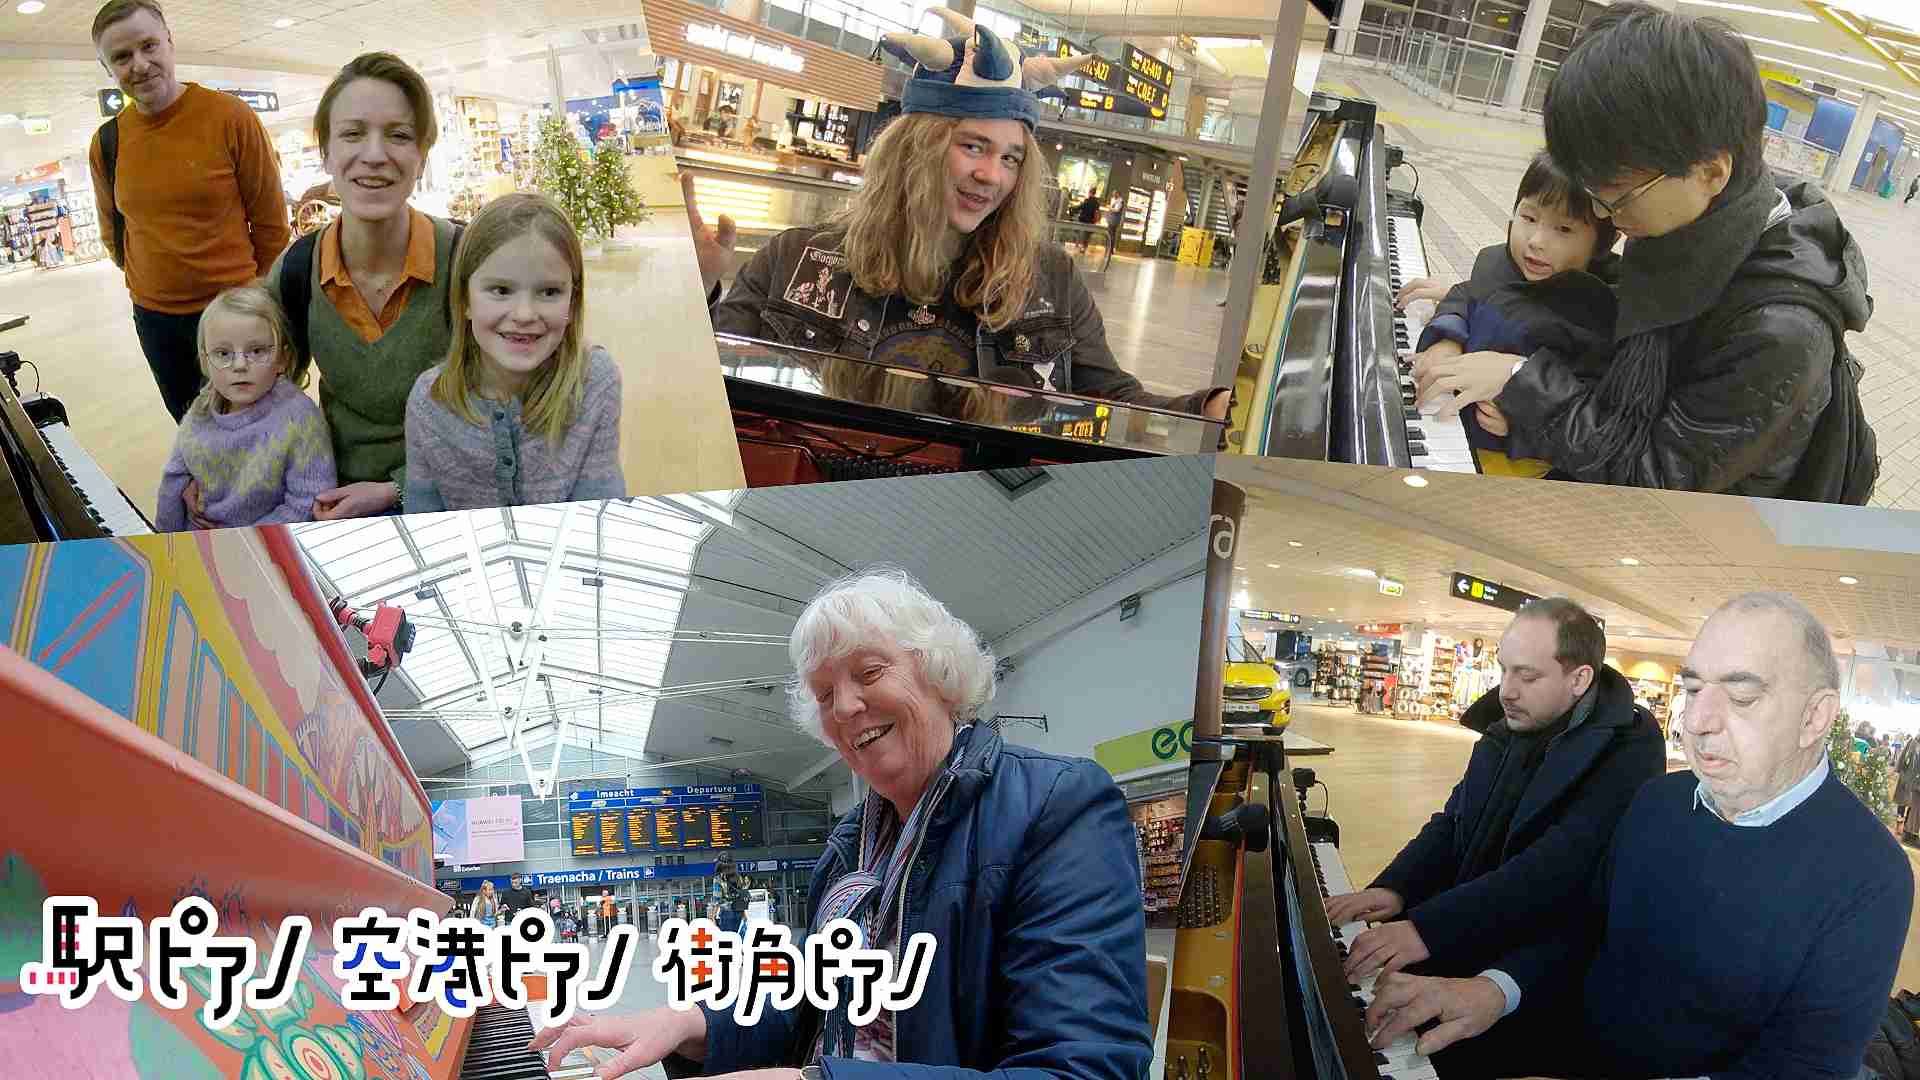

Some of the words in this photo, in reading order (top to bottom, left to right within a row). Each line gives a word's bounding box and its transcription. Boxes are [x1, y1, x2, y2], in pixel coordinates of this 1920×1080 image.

[687, 784, 737, 795] Departures
[536, 872, 596, 885] Traenacha
[606, 867, 641, 881] Trains
